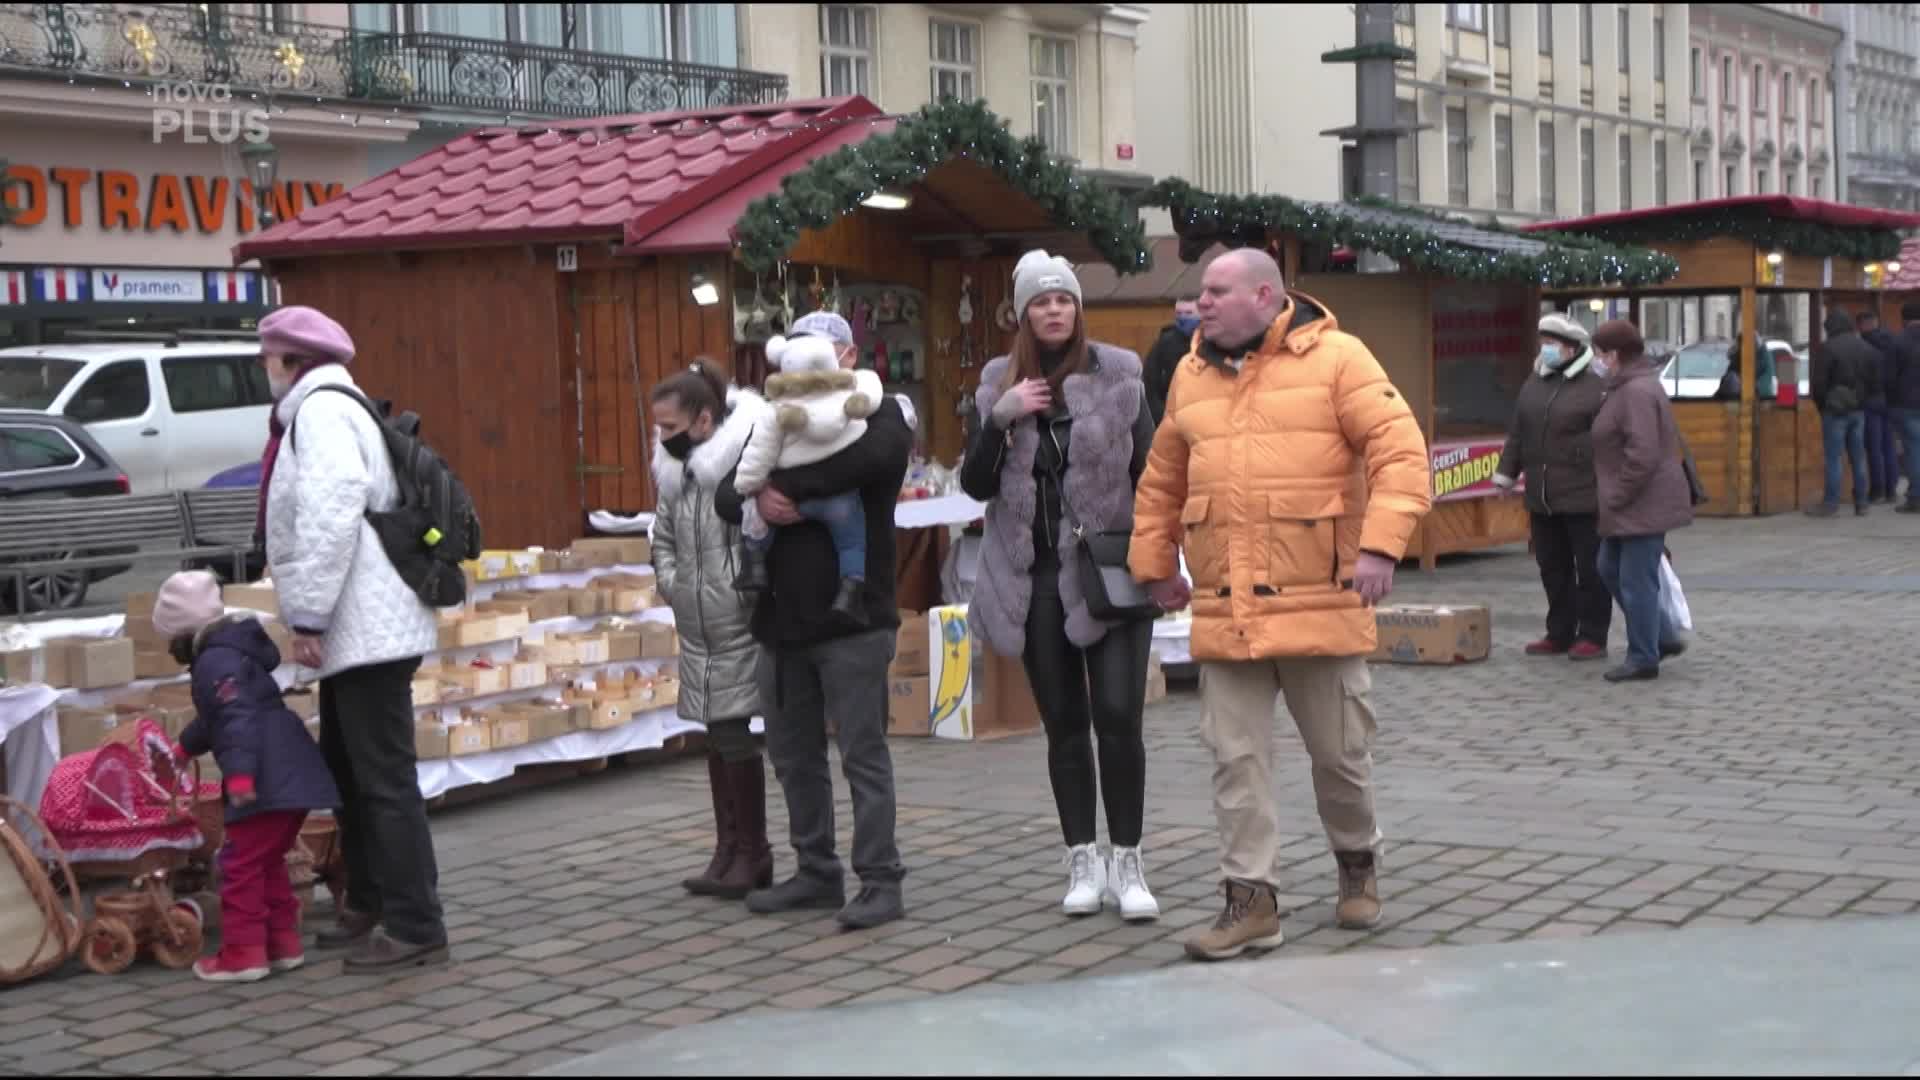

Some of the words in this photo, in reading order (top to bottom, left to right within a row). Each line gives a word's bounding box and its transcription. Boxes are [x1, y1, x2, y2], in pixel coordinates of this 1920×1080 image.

[559, 249, 574, 267] 17
[122, 280, 182, 297] pramen
[1435, 453, 1500, 497] BRAMBOR
